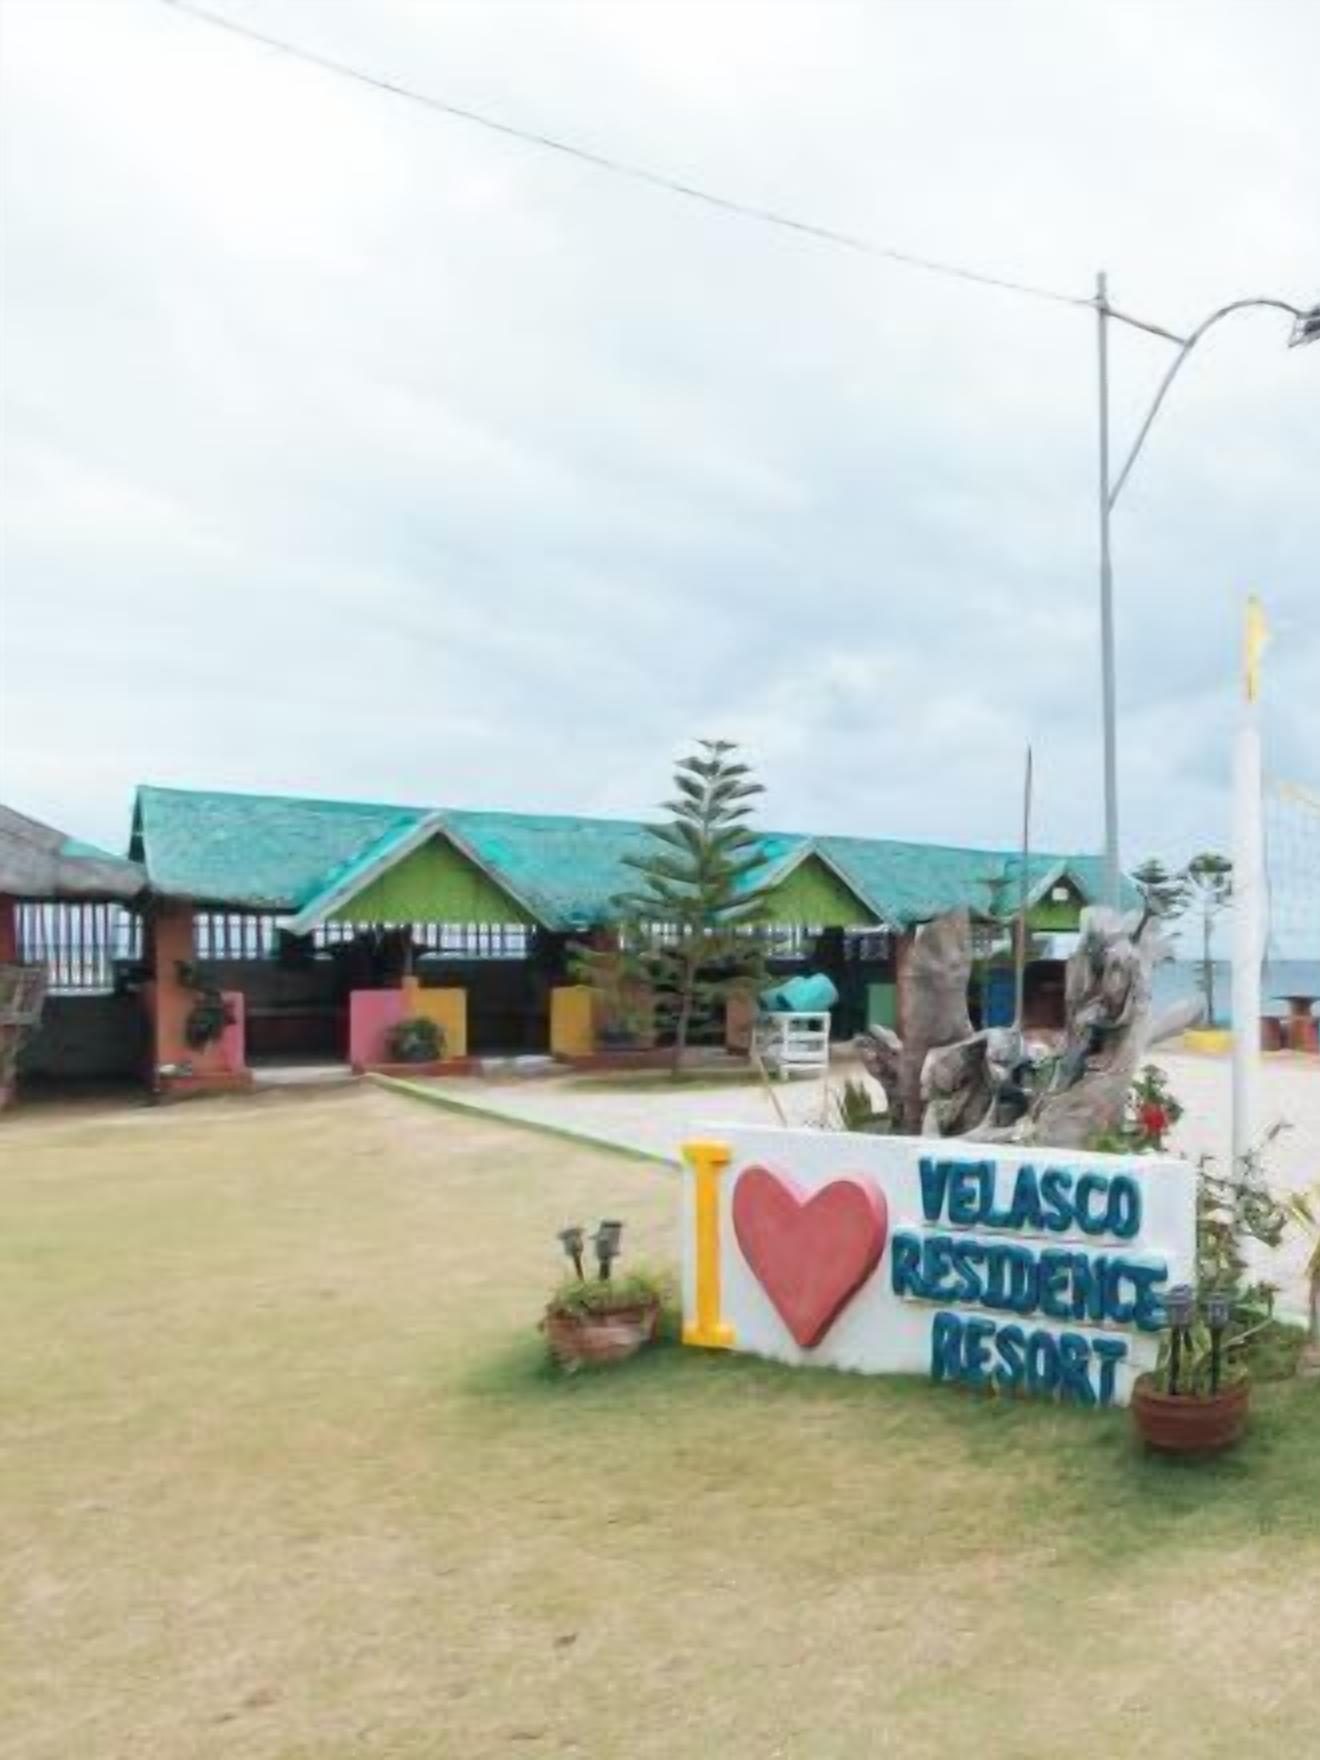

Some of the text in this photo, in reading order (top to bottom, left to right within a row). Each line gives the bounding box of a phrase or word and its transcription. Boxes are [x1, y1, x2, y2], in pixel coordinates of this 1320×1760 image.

[682, 1140, 734, 1347] I
[918, 1155, 1141, 1239] VELASCO
[891, 1230, 1169, 1332] RESIDENCE
[930, 1311, 1128, 1408] RESORT
